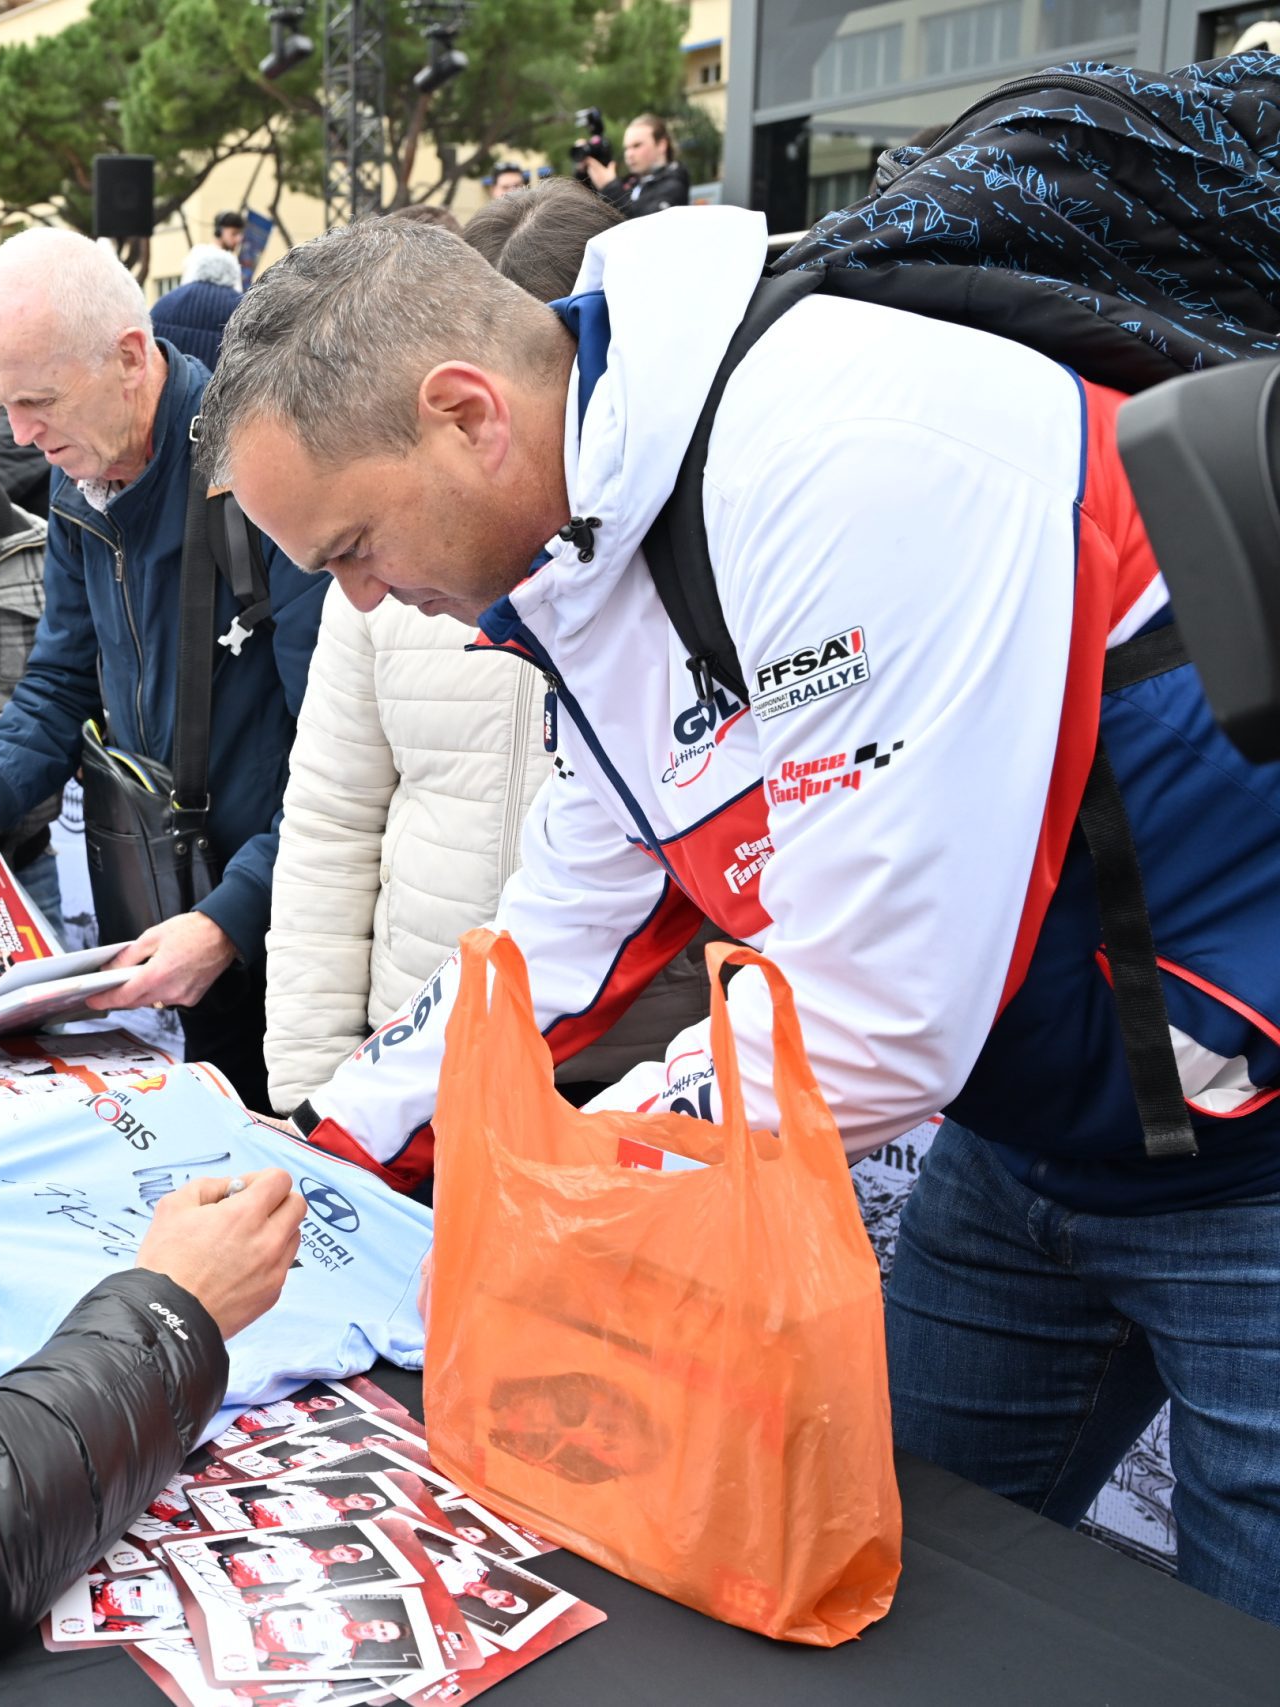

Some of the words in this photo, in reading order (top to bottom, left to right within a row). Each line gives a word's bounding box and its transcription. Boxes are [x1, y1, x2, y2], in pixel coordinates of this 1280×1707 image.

[757, 638, 850, 692] FFSA
[789, 662, 866, 706] RALLYE
[761, 708, 768, 718] DE
[768, 701, 790, 715] FRANCE
[781, 752, 847, 783] Race
[768, 770, 861, 806] Factory
[662, 1058, 714, 1099] pétition
[300, 1234, 341, 1272] SPORT
